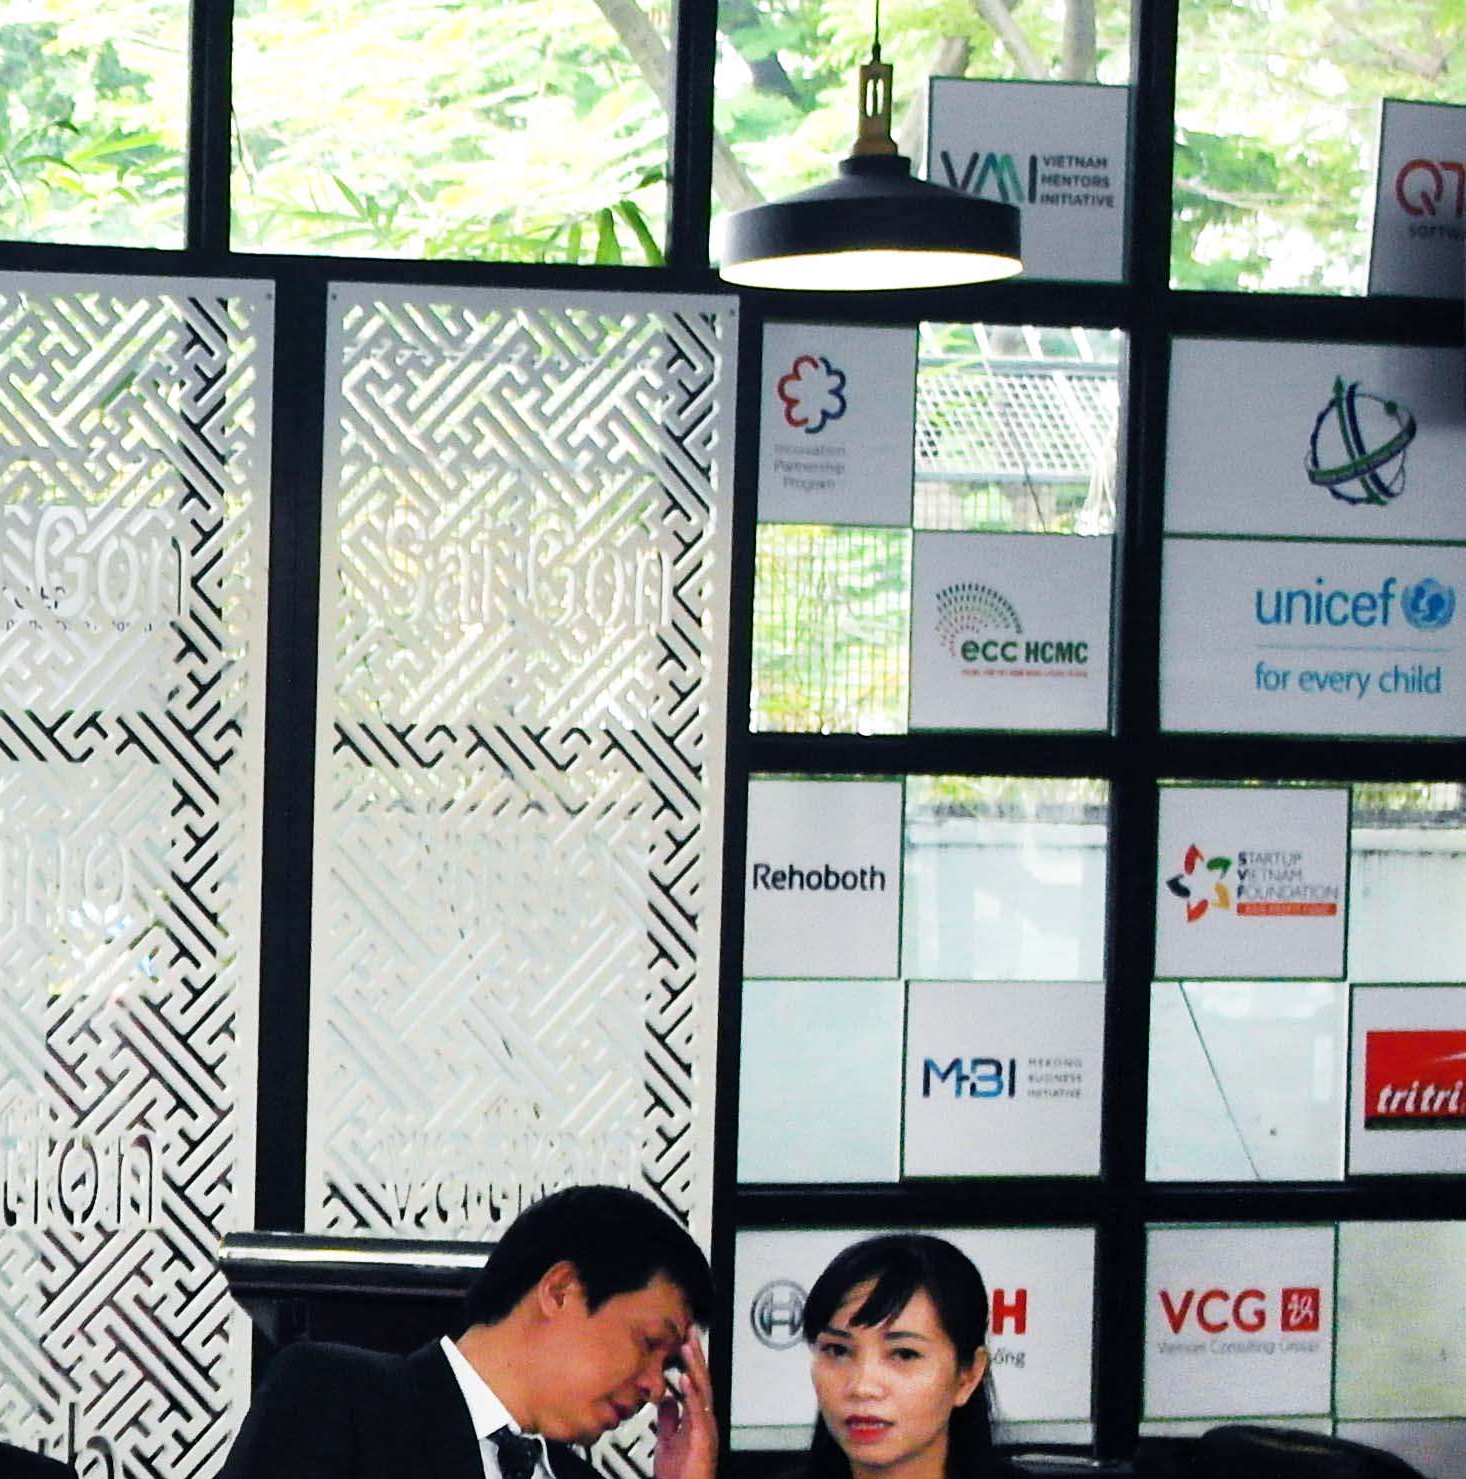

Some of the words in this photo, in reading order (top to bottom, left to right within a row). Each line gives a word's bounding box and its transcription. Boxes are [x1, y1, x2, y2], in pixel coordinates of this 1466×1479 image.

[1043, 155, 1107, 169] VIETNAM
[1041, 174, 1110, 188] MENTORS
[1040, 194, 1114, 208] INITIATIVE
[1256, 577, 1396, 626] unicef
[961, 640, 1017, 662] ecc
[1025, 641, 1088, 664] HCMC
[1256, 661, 1291, 690] for
[1298, 669, 1371, 699] every
[1379, 665, 1442, 693] child
[753, 864, 885, 891] Rehoboth
[1028, 1058, 1082, 1068] MEKONG
[1028, 1074, 1082, 1083] BUSINESS
[1028, 1089, 1081, 1099] INITIATIVE
[1159, 1288, 1266, 1334] VCG
